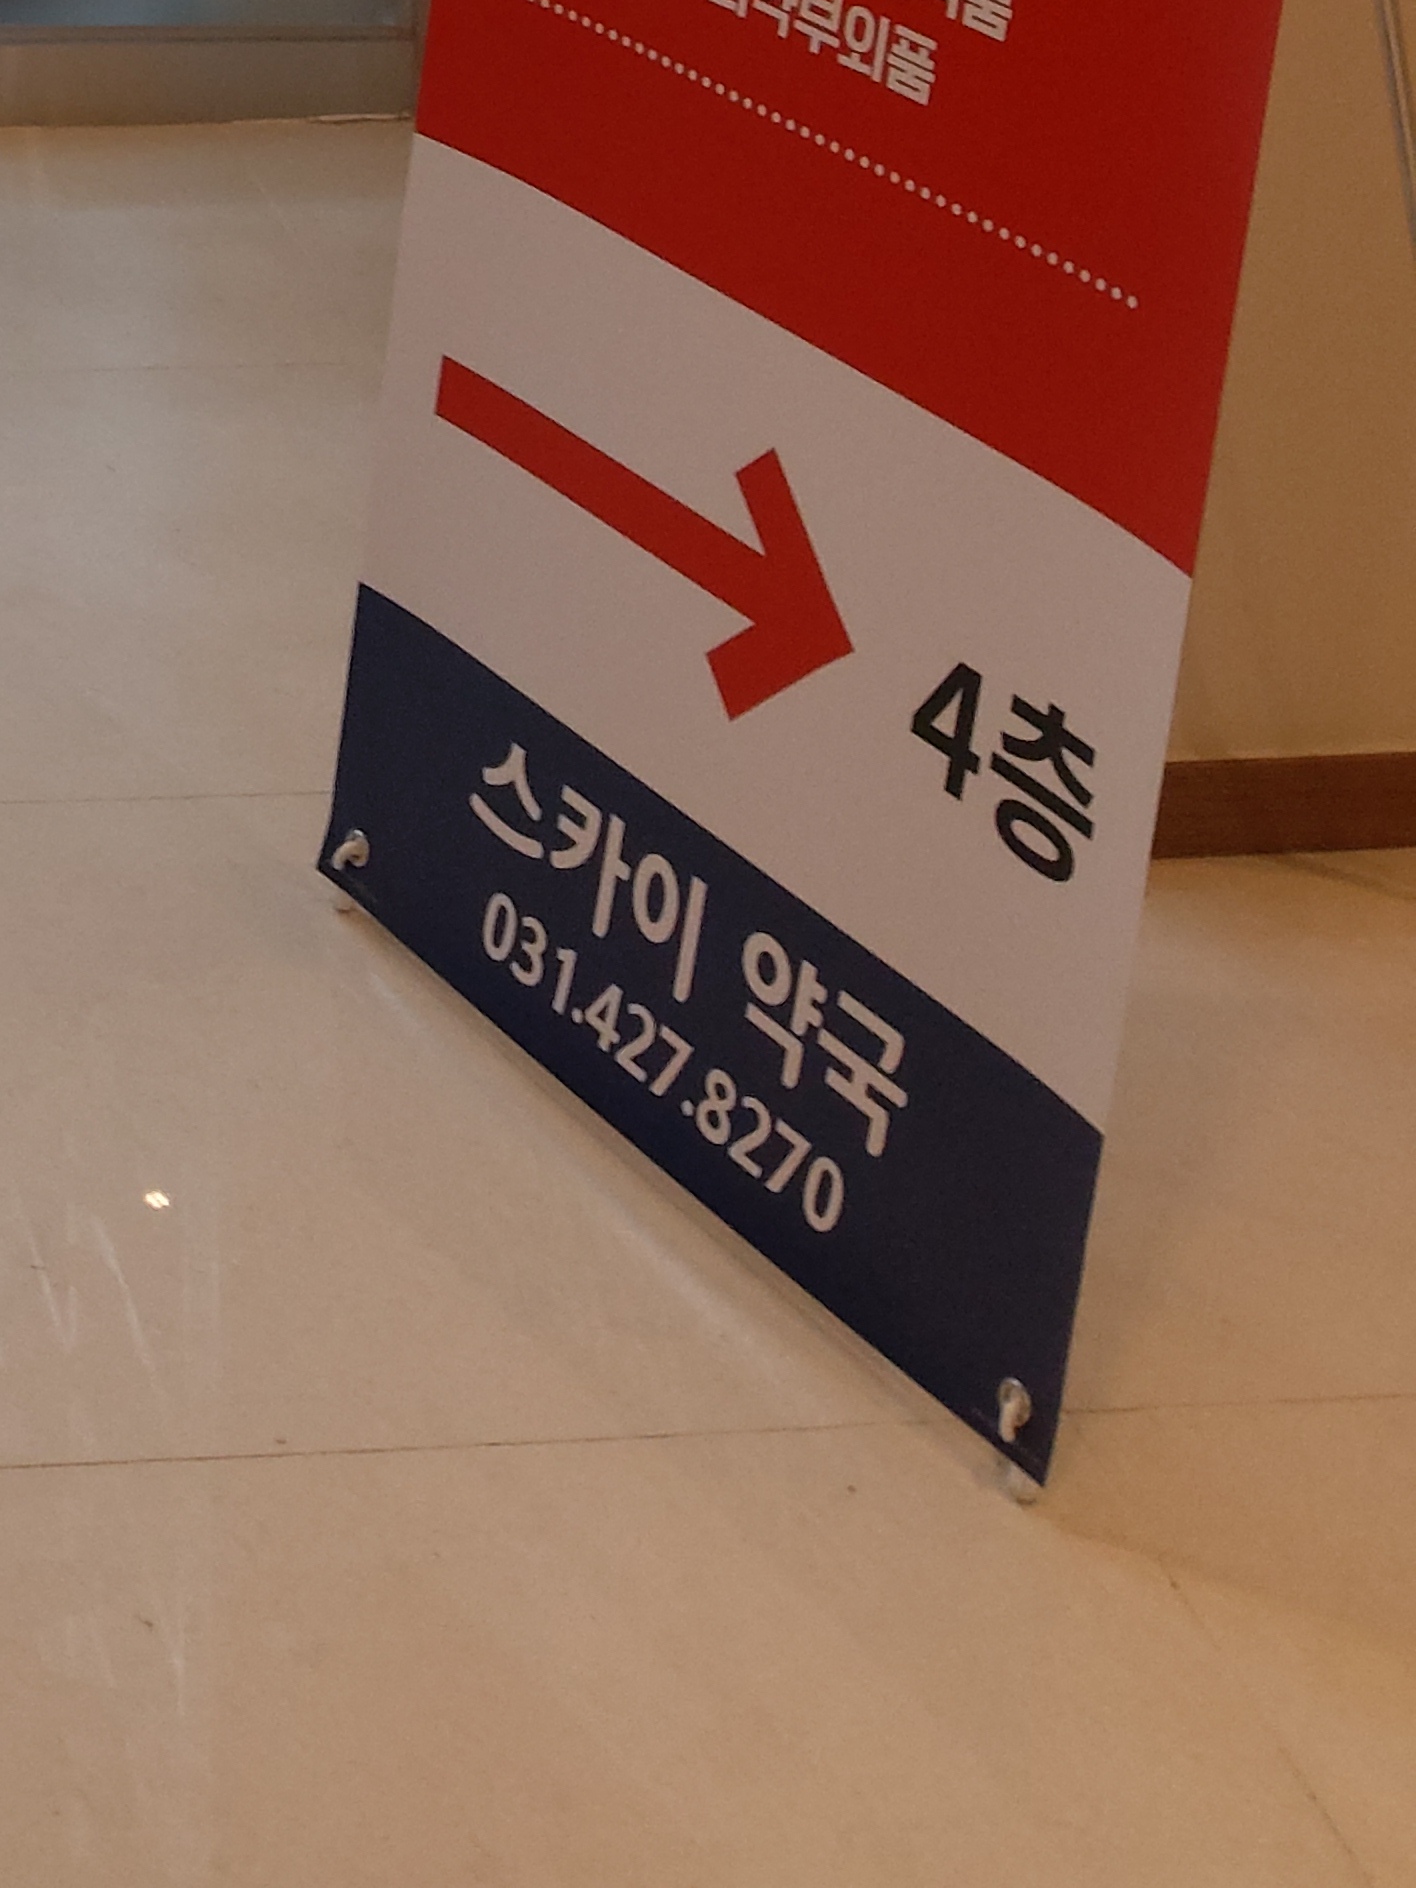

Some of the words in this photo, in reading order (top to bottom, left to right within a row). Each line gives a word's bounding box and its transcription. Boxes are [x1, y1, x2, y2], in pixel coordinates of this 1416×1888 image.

[910, 662, 1097, 883] 4층
[469, 742, 708, 1004] 스카이
[740, 930, 909, 1158] 약국
[481, 891, 847, 1234] 031.427.8270
